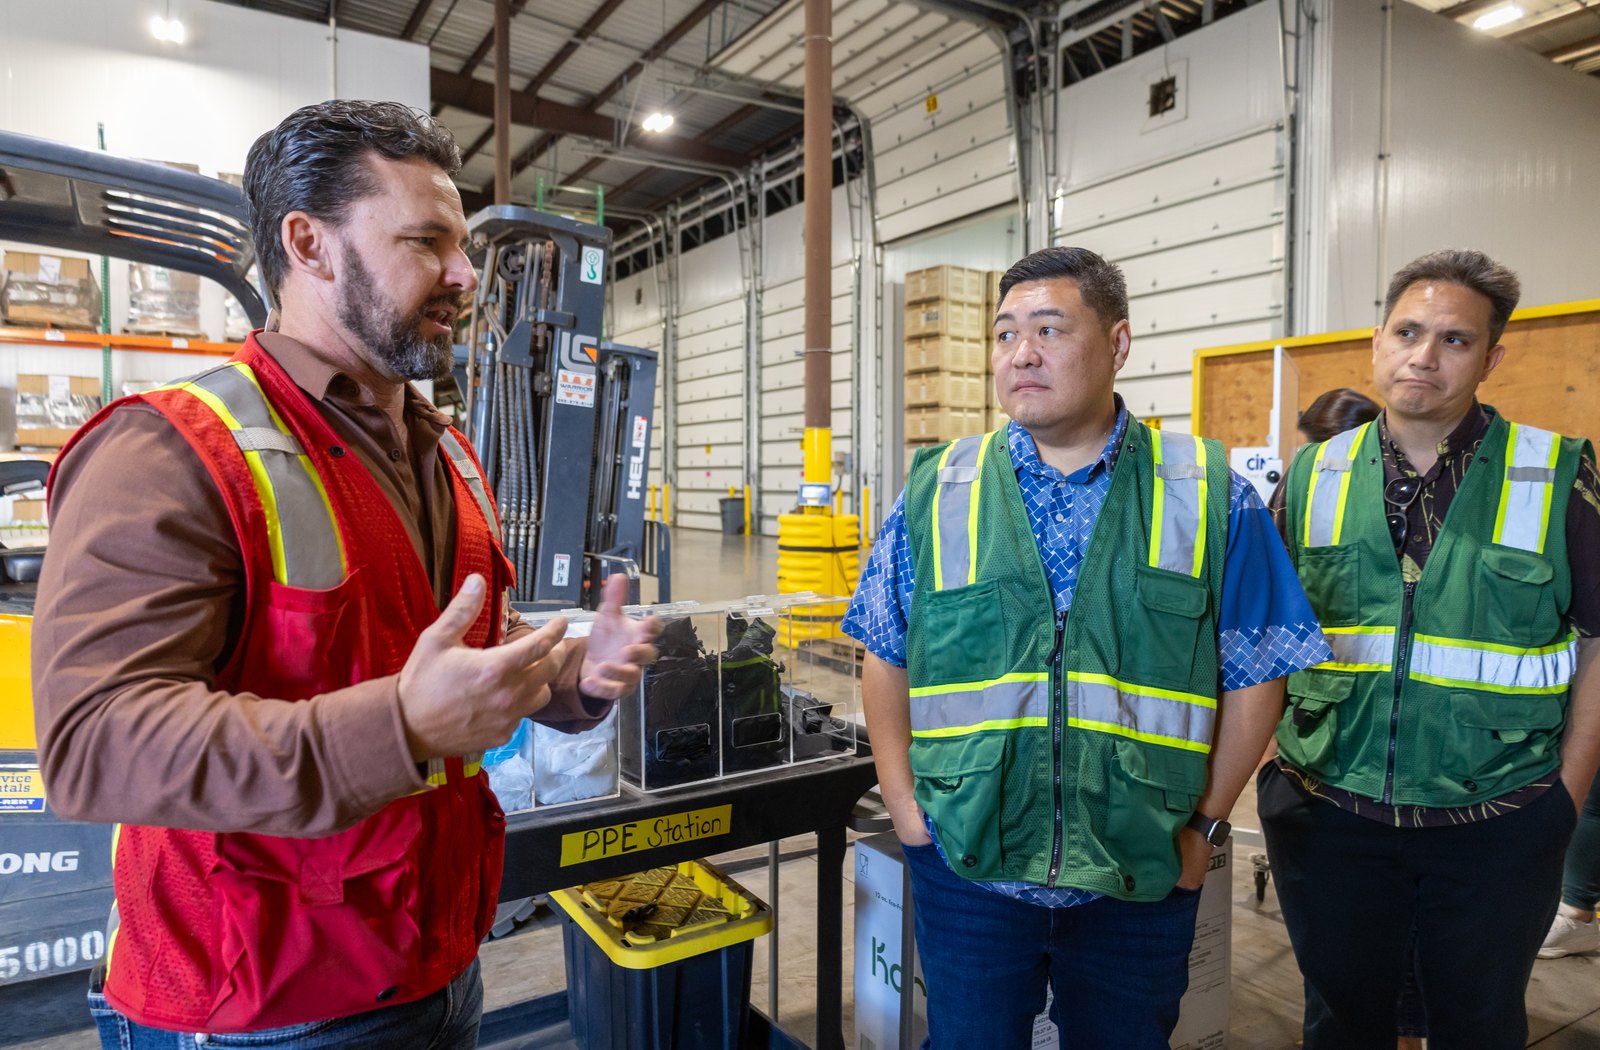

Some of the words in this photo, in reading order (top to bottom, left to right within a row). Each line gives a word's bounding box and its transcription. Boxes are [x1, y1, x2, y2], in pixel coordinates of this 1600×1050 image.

[627, 440, 646, 499] HELI
[582, 824, 637, 859] PPE
[647, 813, 722, 847] Station
[0, 850, 79, 874] ONG
[0, 930, 104, 978] 5000
